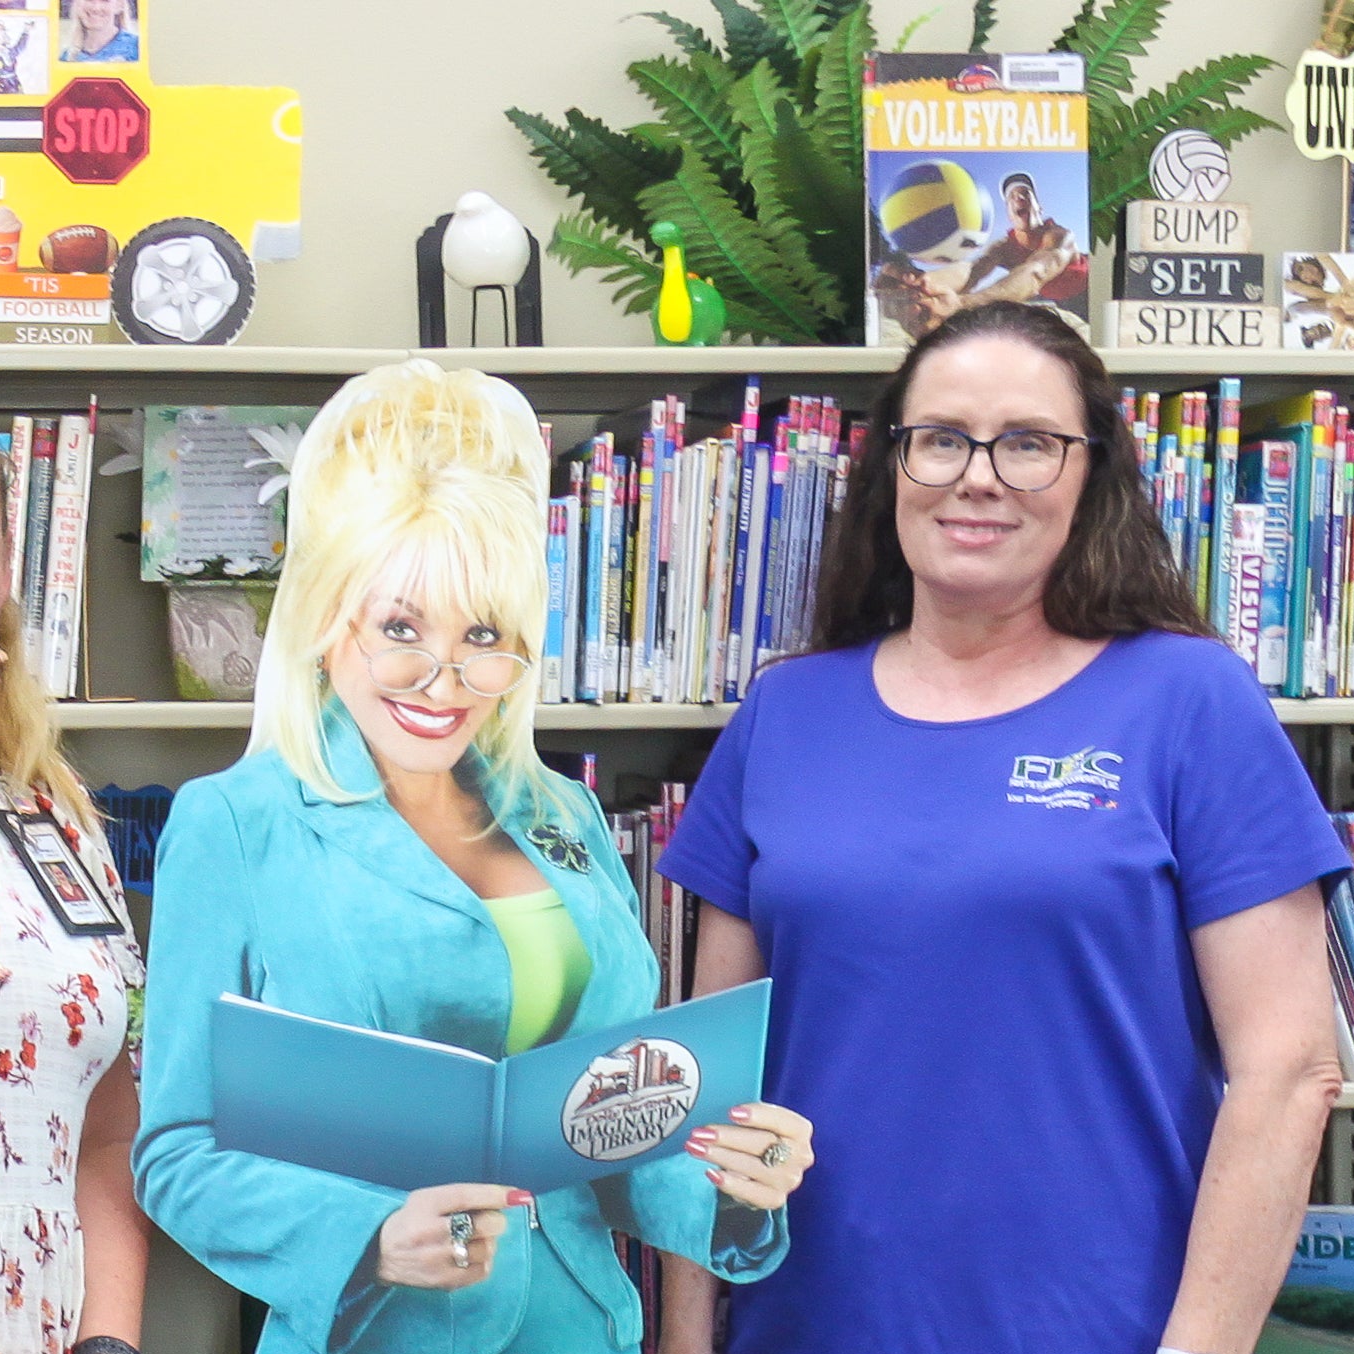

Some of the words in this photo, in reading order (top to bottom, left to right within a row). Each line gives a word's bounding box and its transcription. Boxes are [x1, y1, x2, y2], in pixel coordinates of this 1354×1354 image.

[54, 108, 140, 154] STOP
[883, 99, 1077, 148] VOLLEYBALL
[1154, 207, 1238, 245] BUMP
[1150, 257, 1241, 297] SET
[3, 302, 101, 318] FOOTBALL
[1136, 306, 1263, 347] SPIKE
[16, 327, 92, 344] SEASON
[569, 1096, 691, 1146] IMAGINATION
[589, 1122, 667, 1159] LIBRARY
